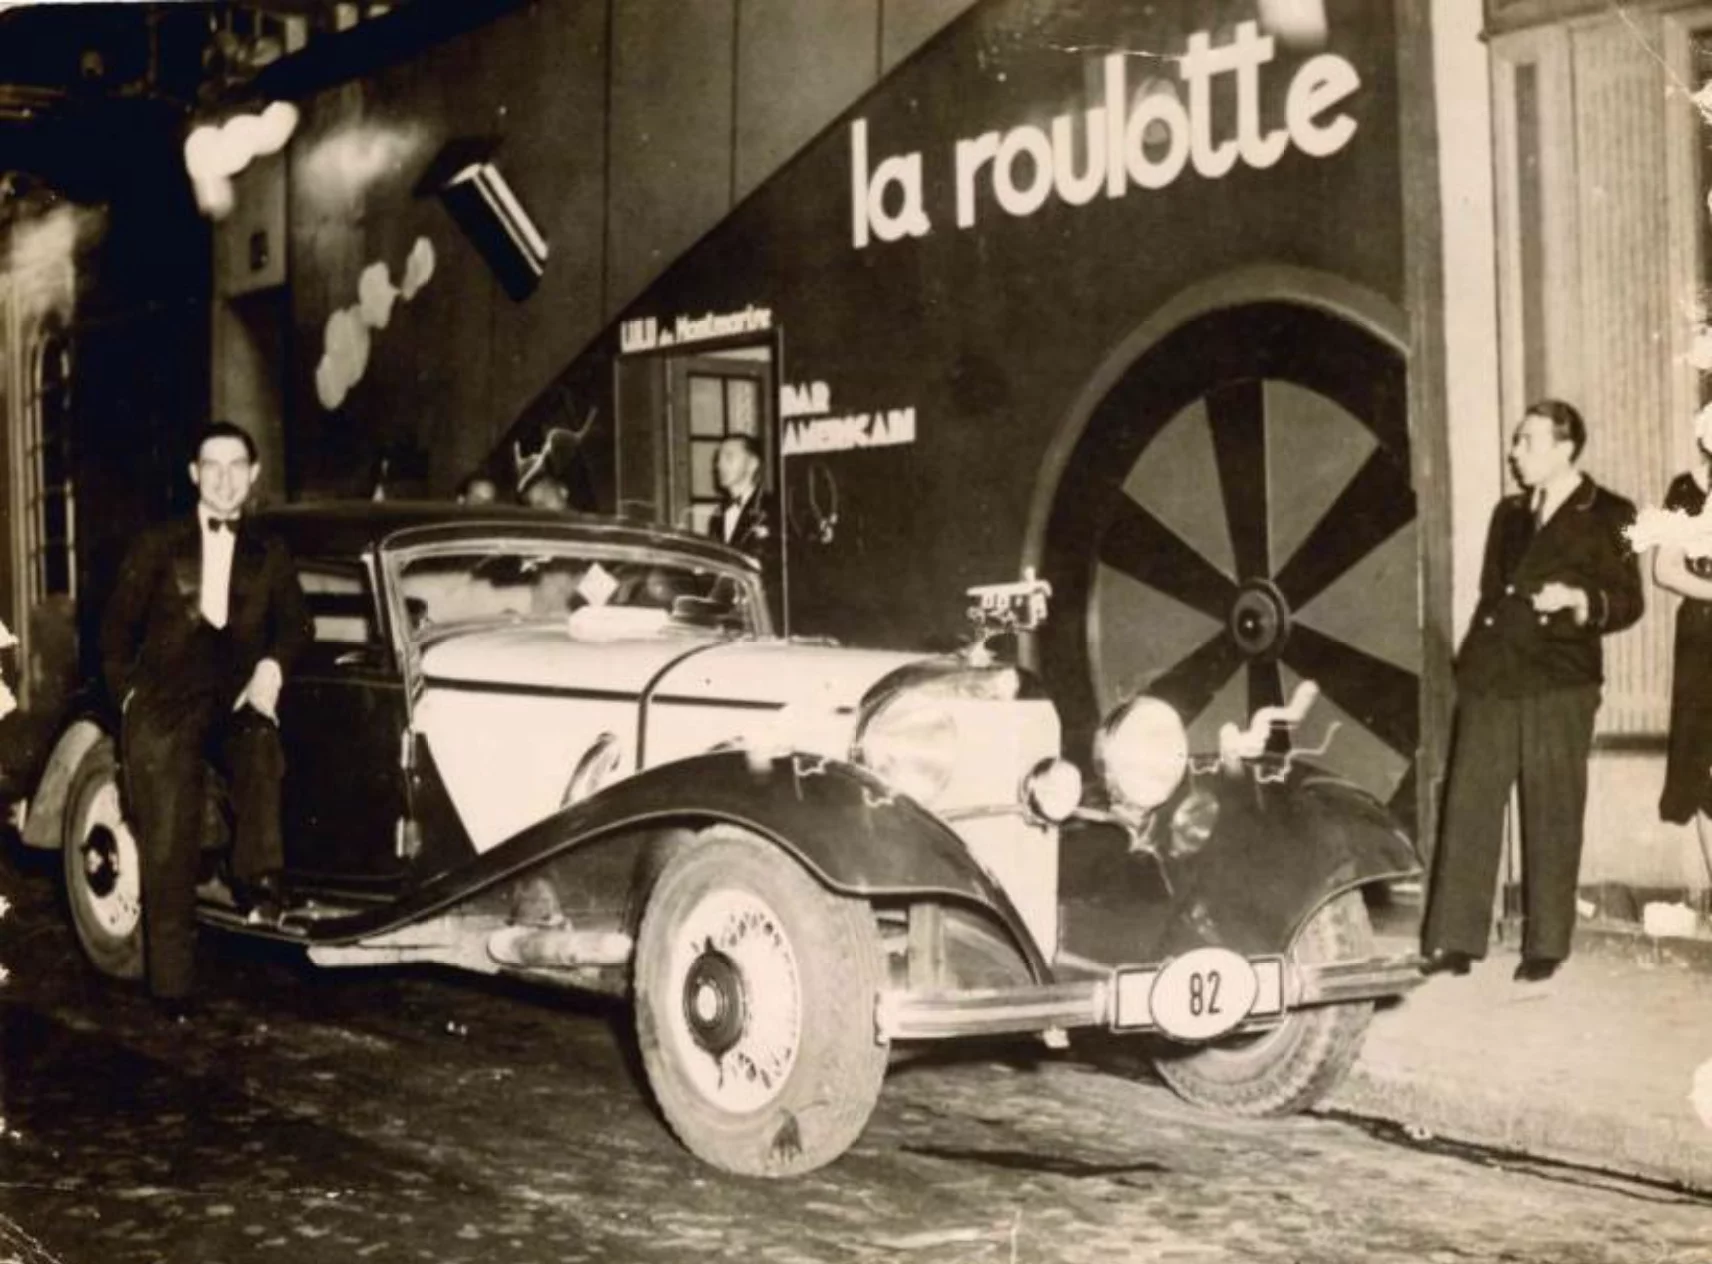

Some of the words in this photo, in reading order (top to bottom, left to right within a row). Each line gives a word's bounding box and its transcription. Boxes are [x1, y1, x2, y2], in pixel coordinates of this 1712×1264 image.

[853, 119, 931, 248] la
[956, 20, 1360, 228] roulotte
[780, 380, 830, 418] BAR
[781, 407, 916, 457] AMERICAIN
[1188, 970, 1222, 1018] 82
